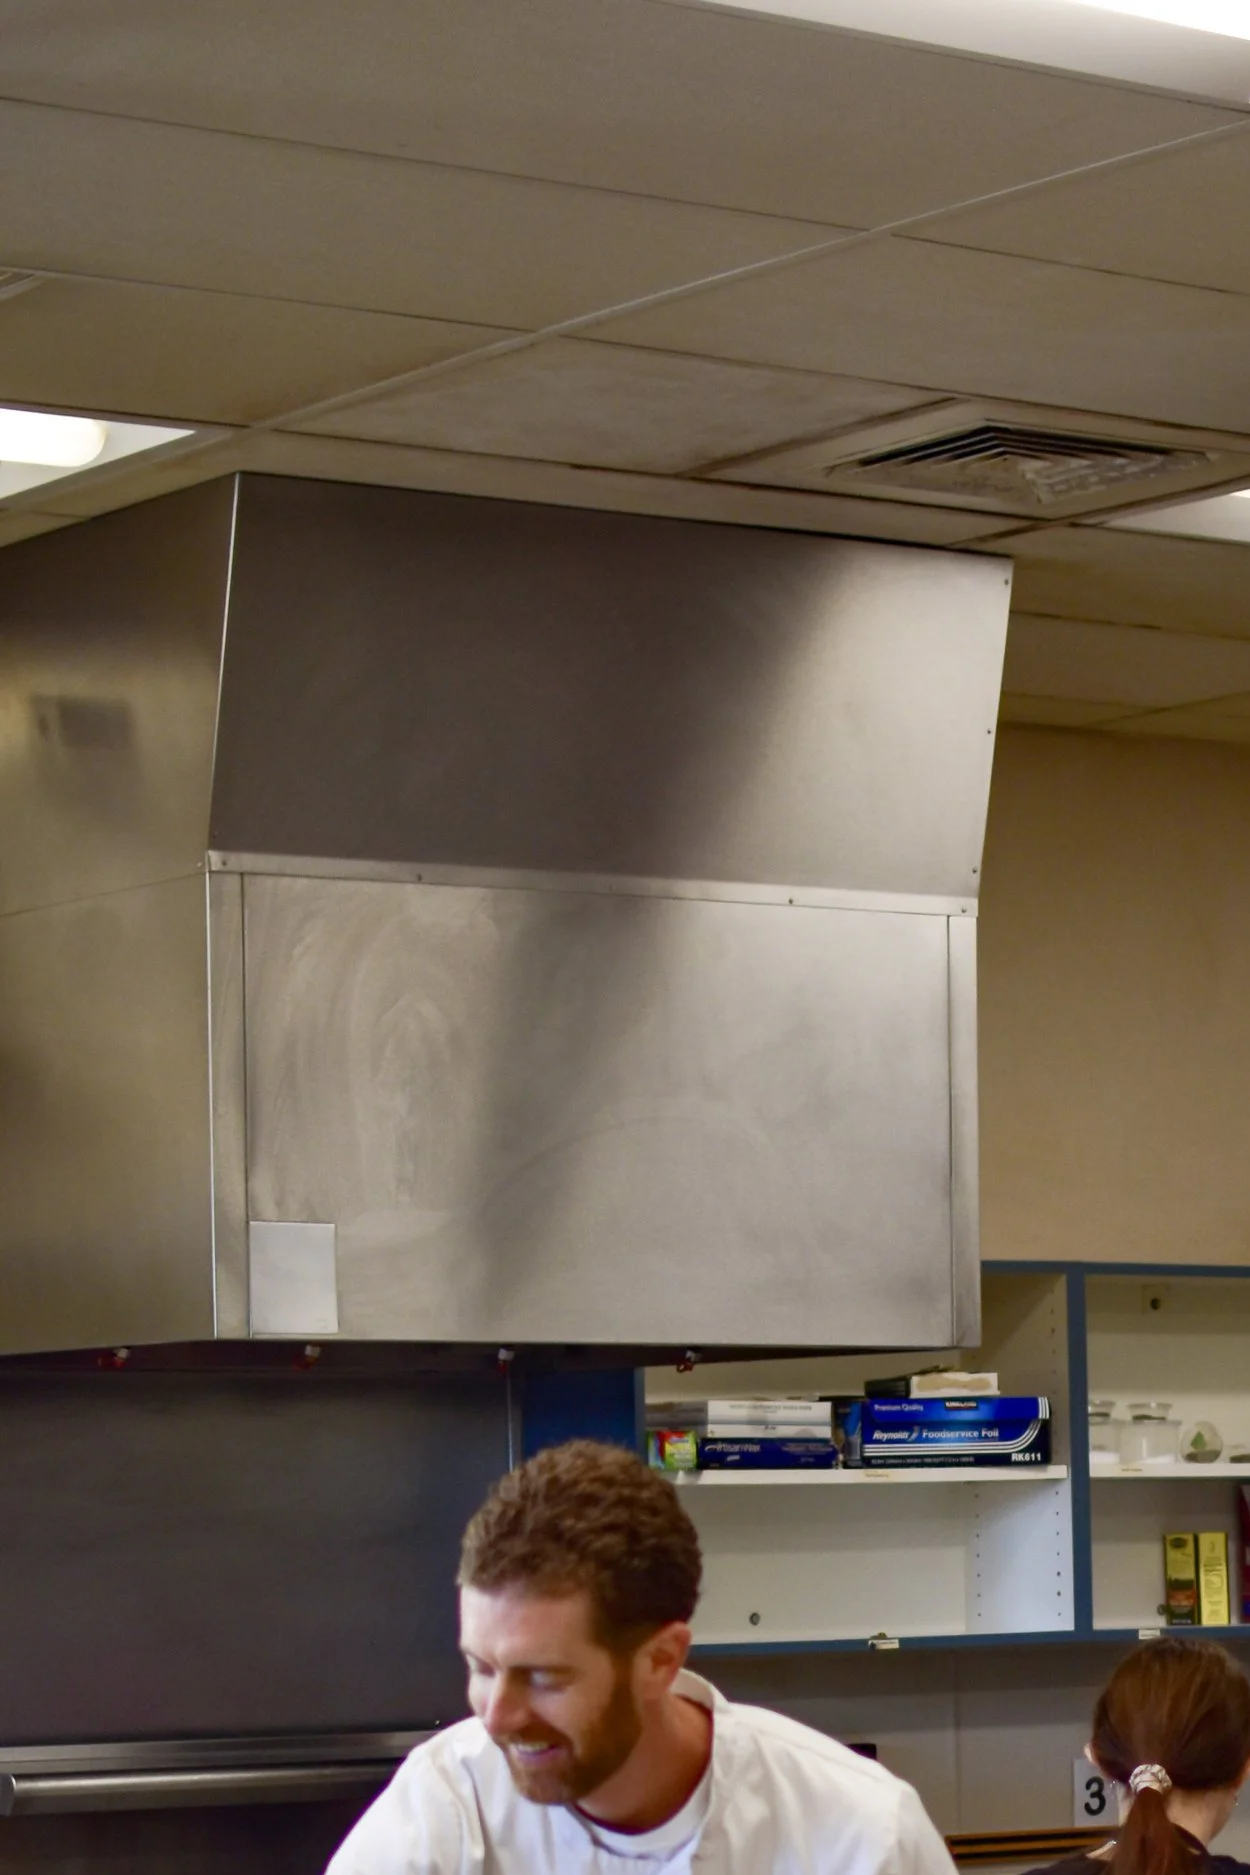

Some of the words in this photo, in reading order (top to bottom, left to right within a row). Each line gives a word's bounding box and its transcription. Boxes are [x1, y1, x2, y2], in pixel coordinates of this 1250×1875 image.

[922, 1429, 979, 1439] Foodservice
[981, 1428, 999, 1437] Foil
[1012, 1453, 1042, 1463] RK611
[1084, 1776, 1107, 1816] 3
